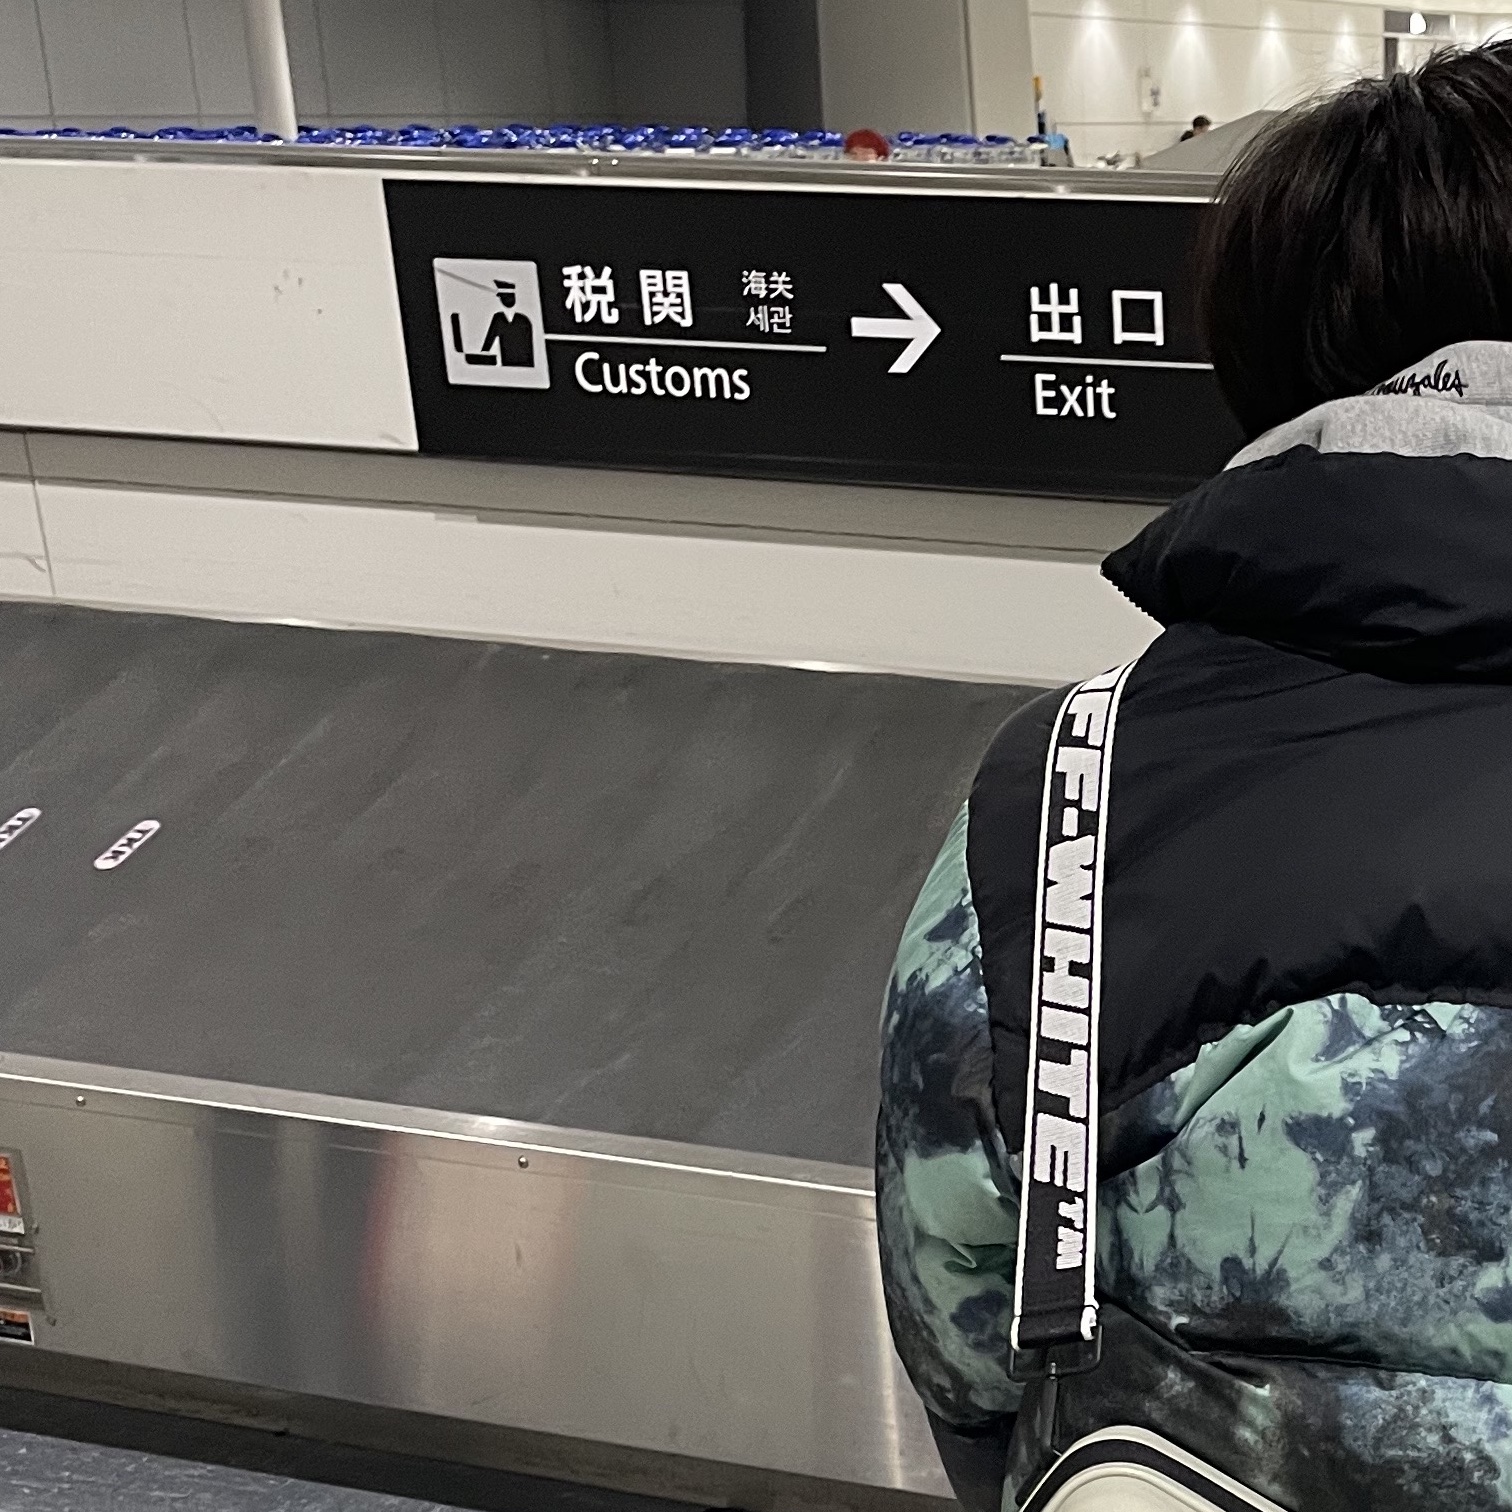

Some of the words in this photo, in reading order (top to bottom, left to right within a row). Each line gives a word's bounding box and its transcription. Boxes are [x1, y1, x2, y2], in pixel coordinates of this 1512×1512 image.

[562, 265, 693, 328] 税関
[740, 269, 795, 301] 海关
[745, 304, 793, 335] 세관
[1029, 282, 1165, 346] 出口
[573, 351, 752, 401] Customs
[1034, 374, 1118, 420] Exit
